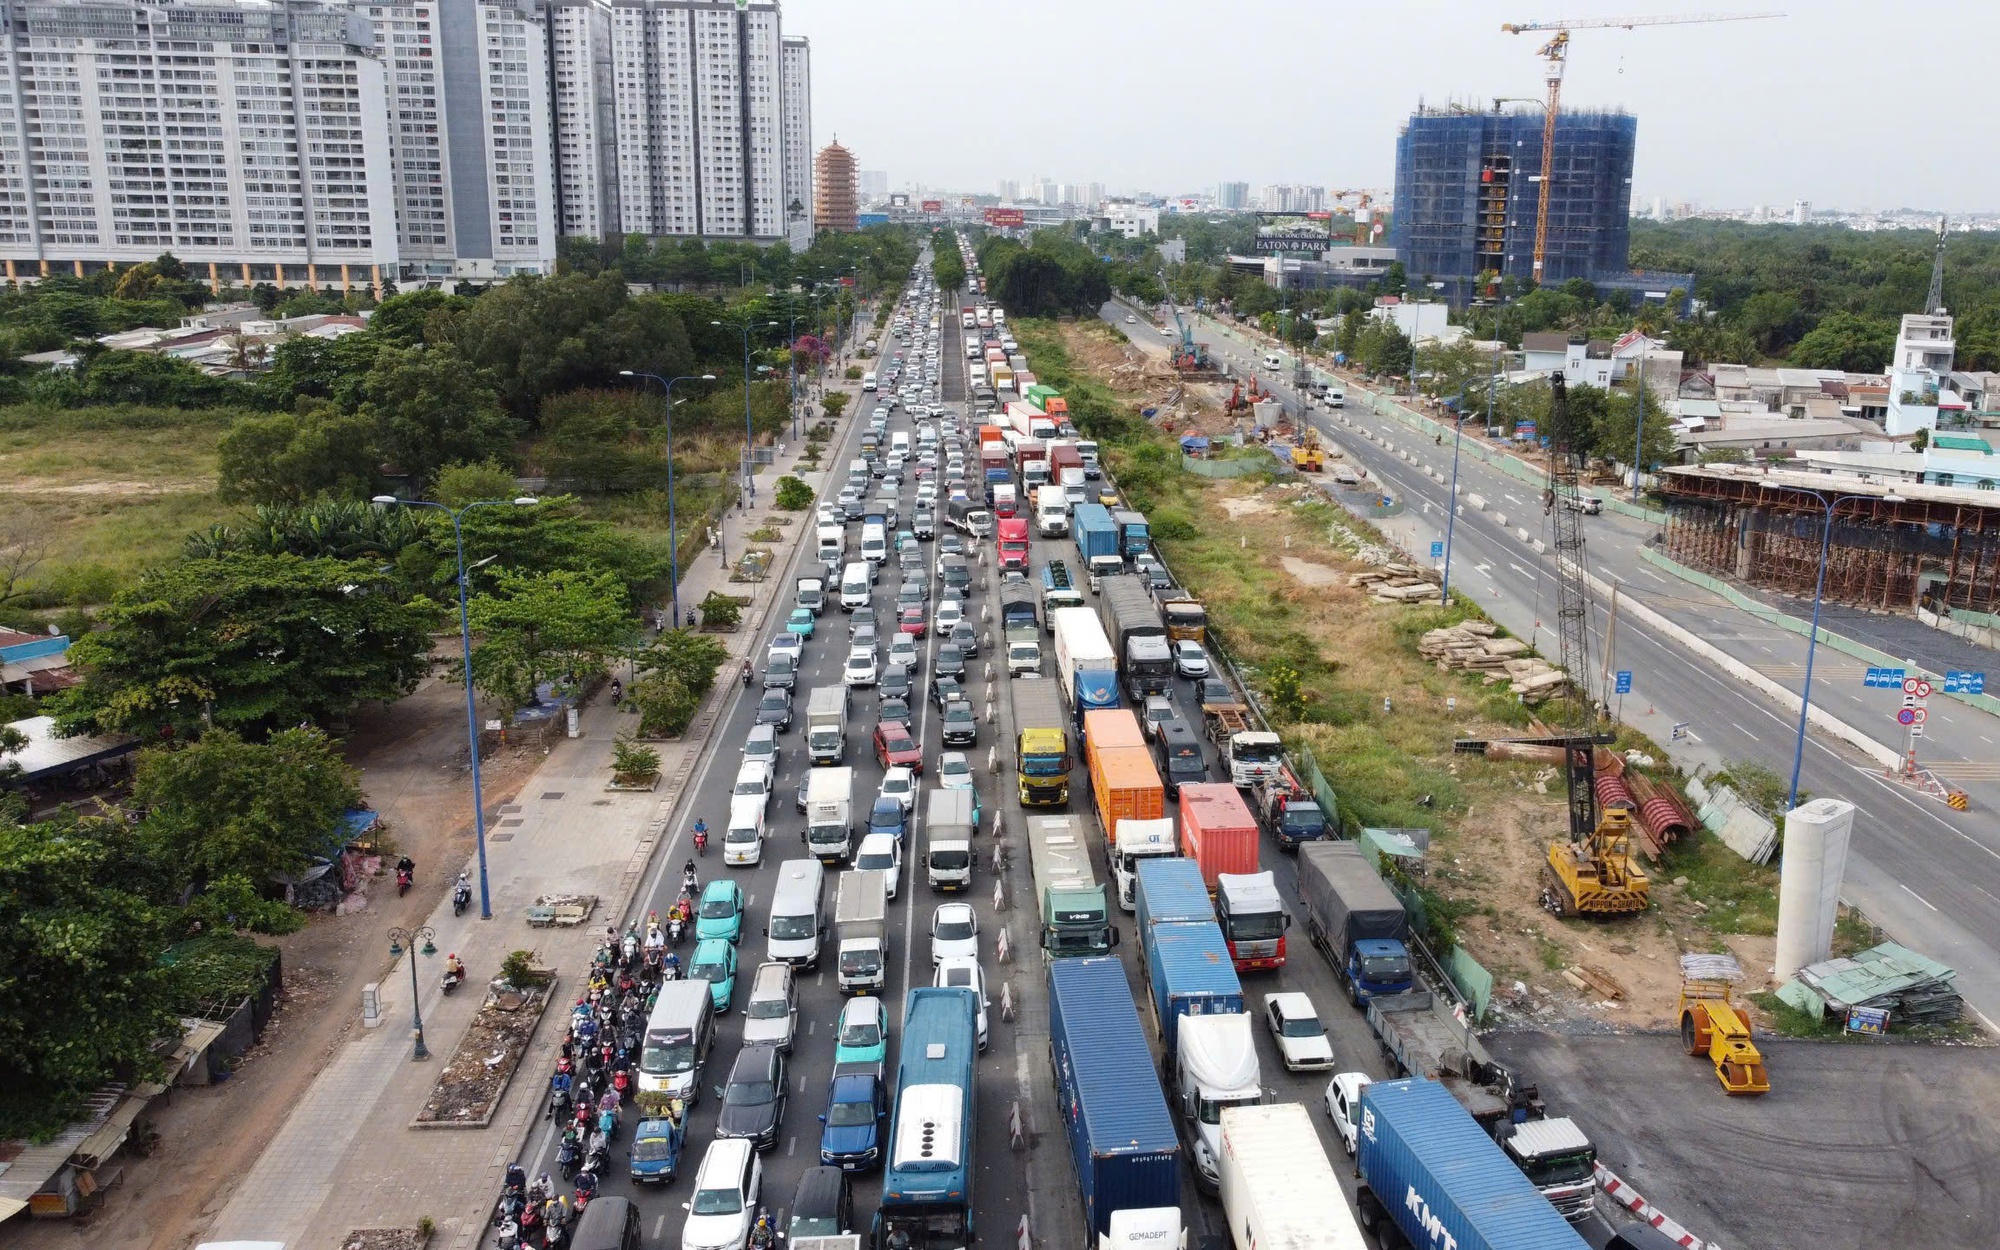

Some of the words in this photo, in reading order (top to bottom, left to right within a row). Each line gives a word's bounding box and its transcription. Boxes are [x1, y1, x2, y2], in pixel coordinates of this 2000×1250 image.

[1256, 241, 1289, 250] EATON
[1301, 242, 1327, 251] PARK
[1129, 1231, 1168, 1241] GEMADEPT
